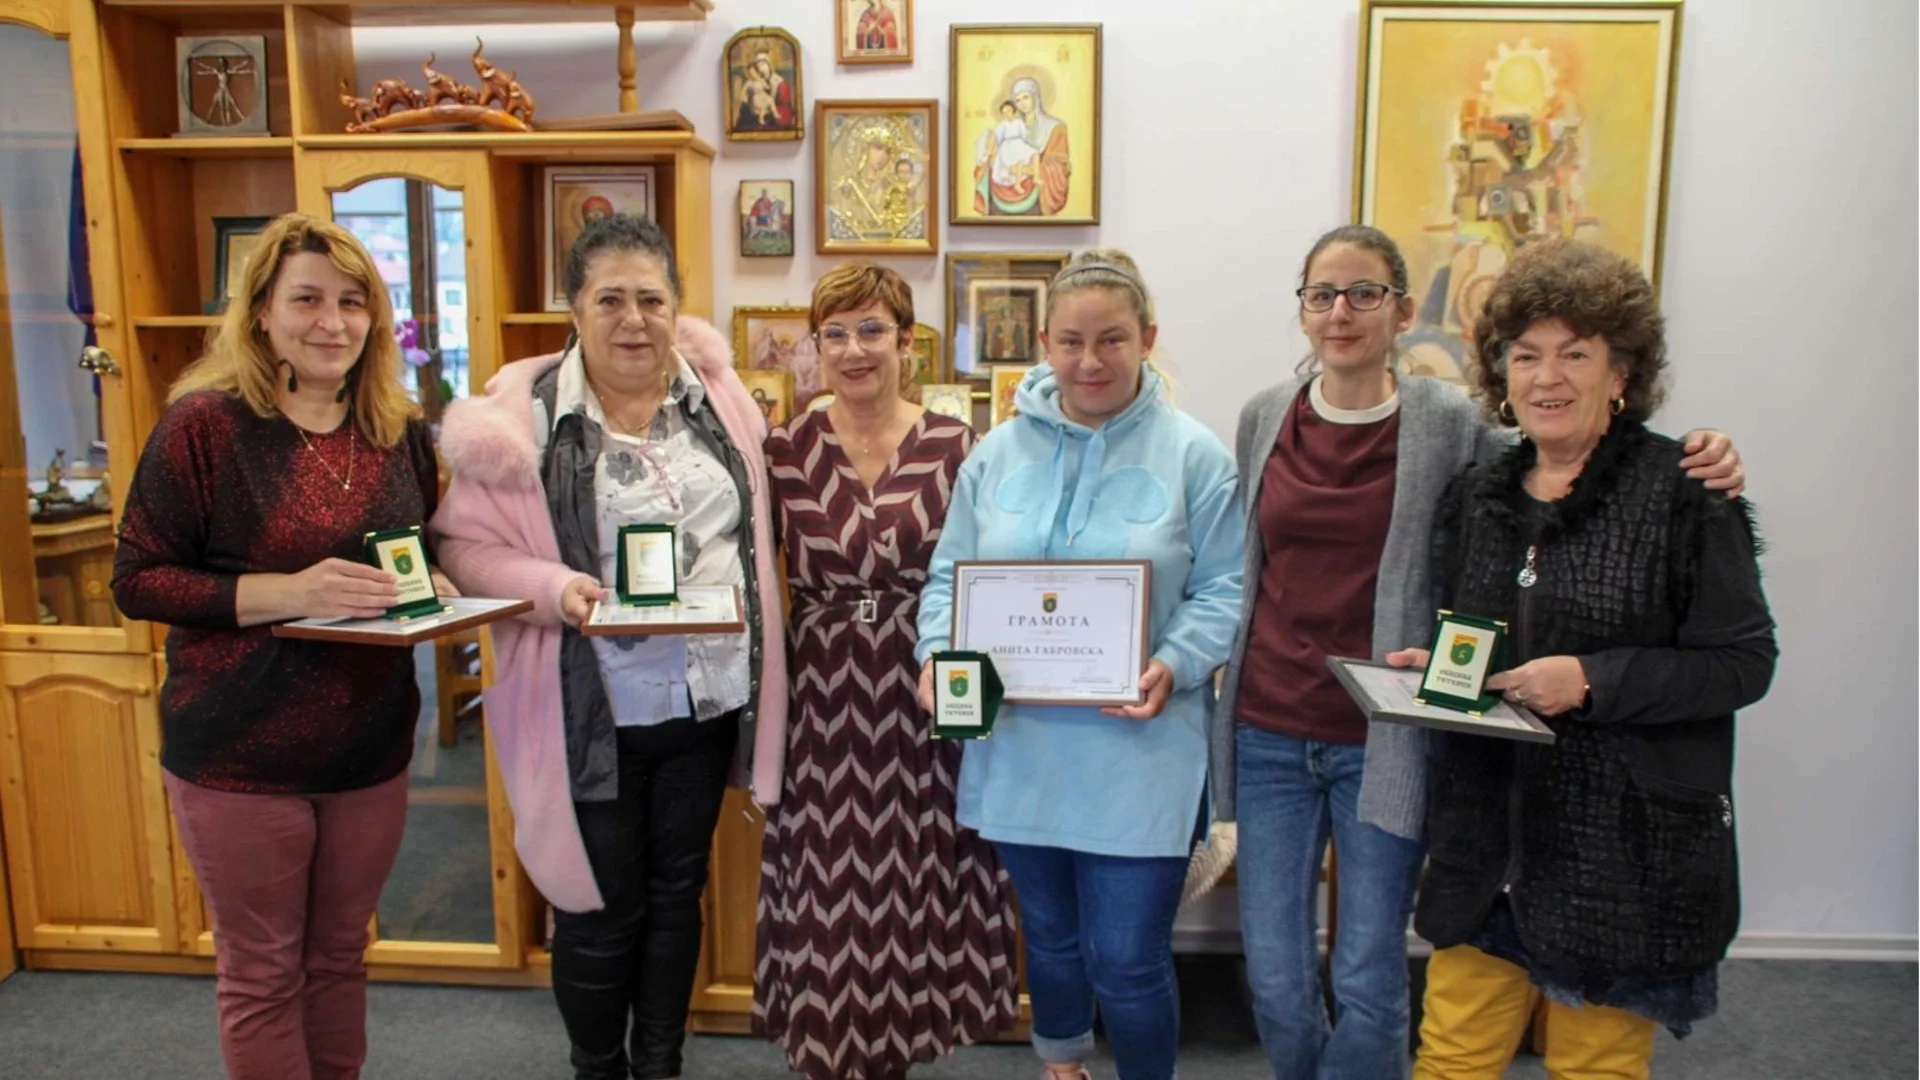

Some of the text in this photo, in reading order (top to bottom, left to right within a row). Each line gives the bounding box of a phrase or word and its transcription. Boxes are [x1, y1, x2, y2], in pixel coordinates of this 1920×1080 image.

[1008, 615, 1089, 627] ГРАМОТА
[991, 645, 1104, 656] АНИТА ГАБРОВСКА
